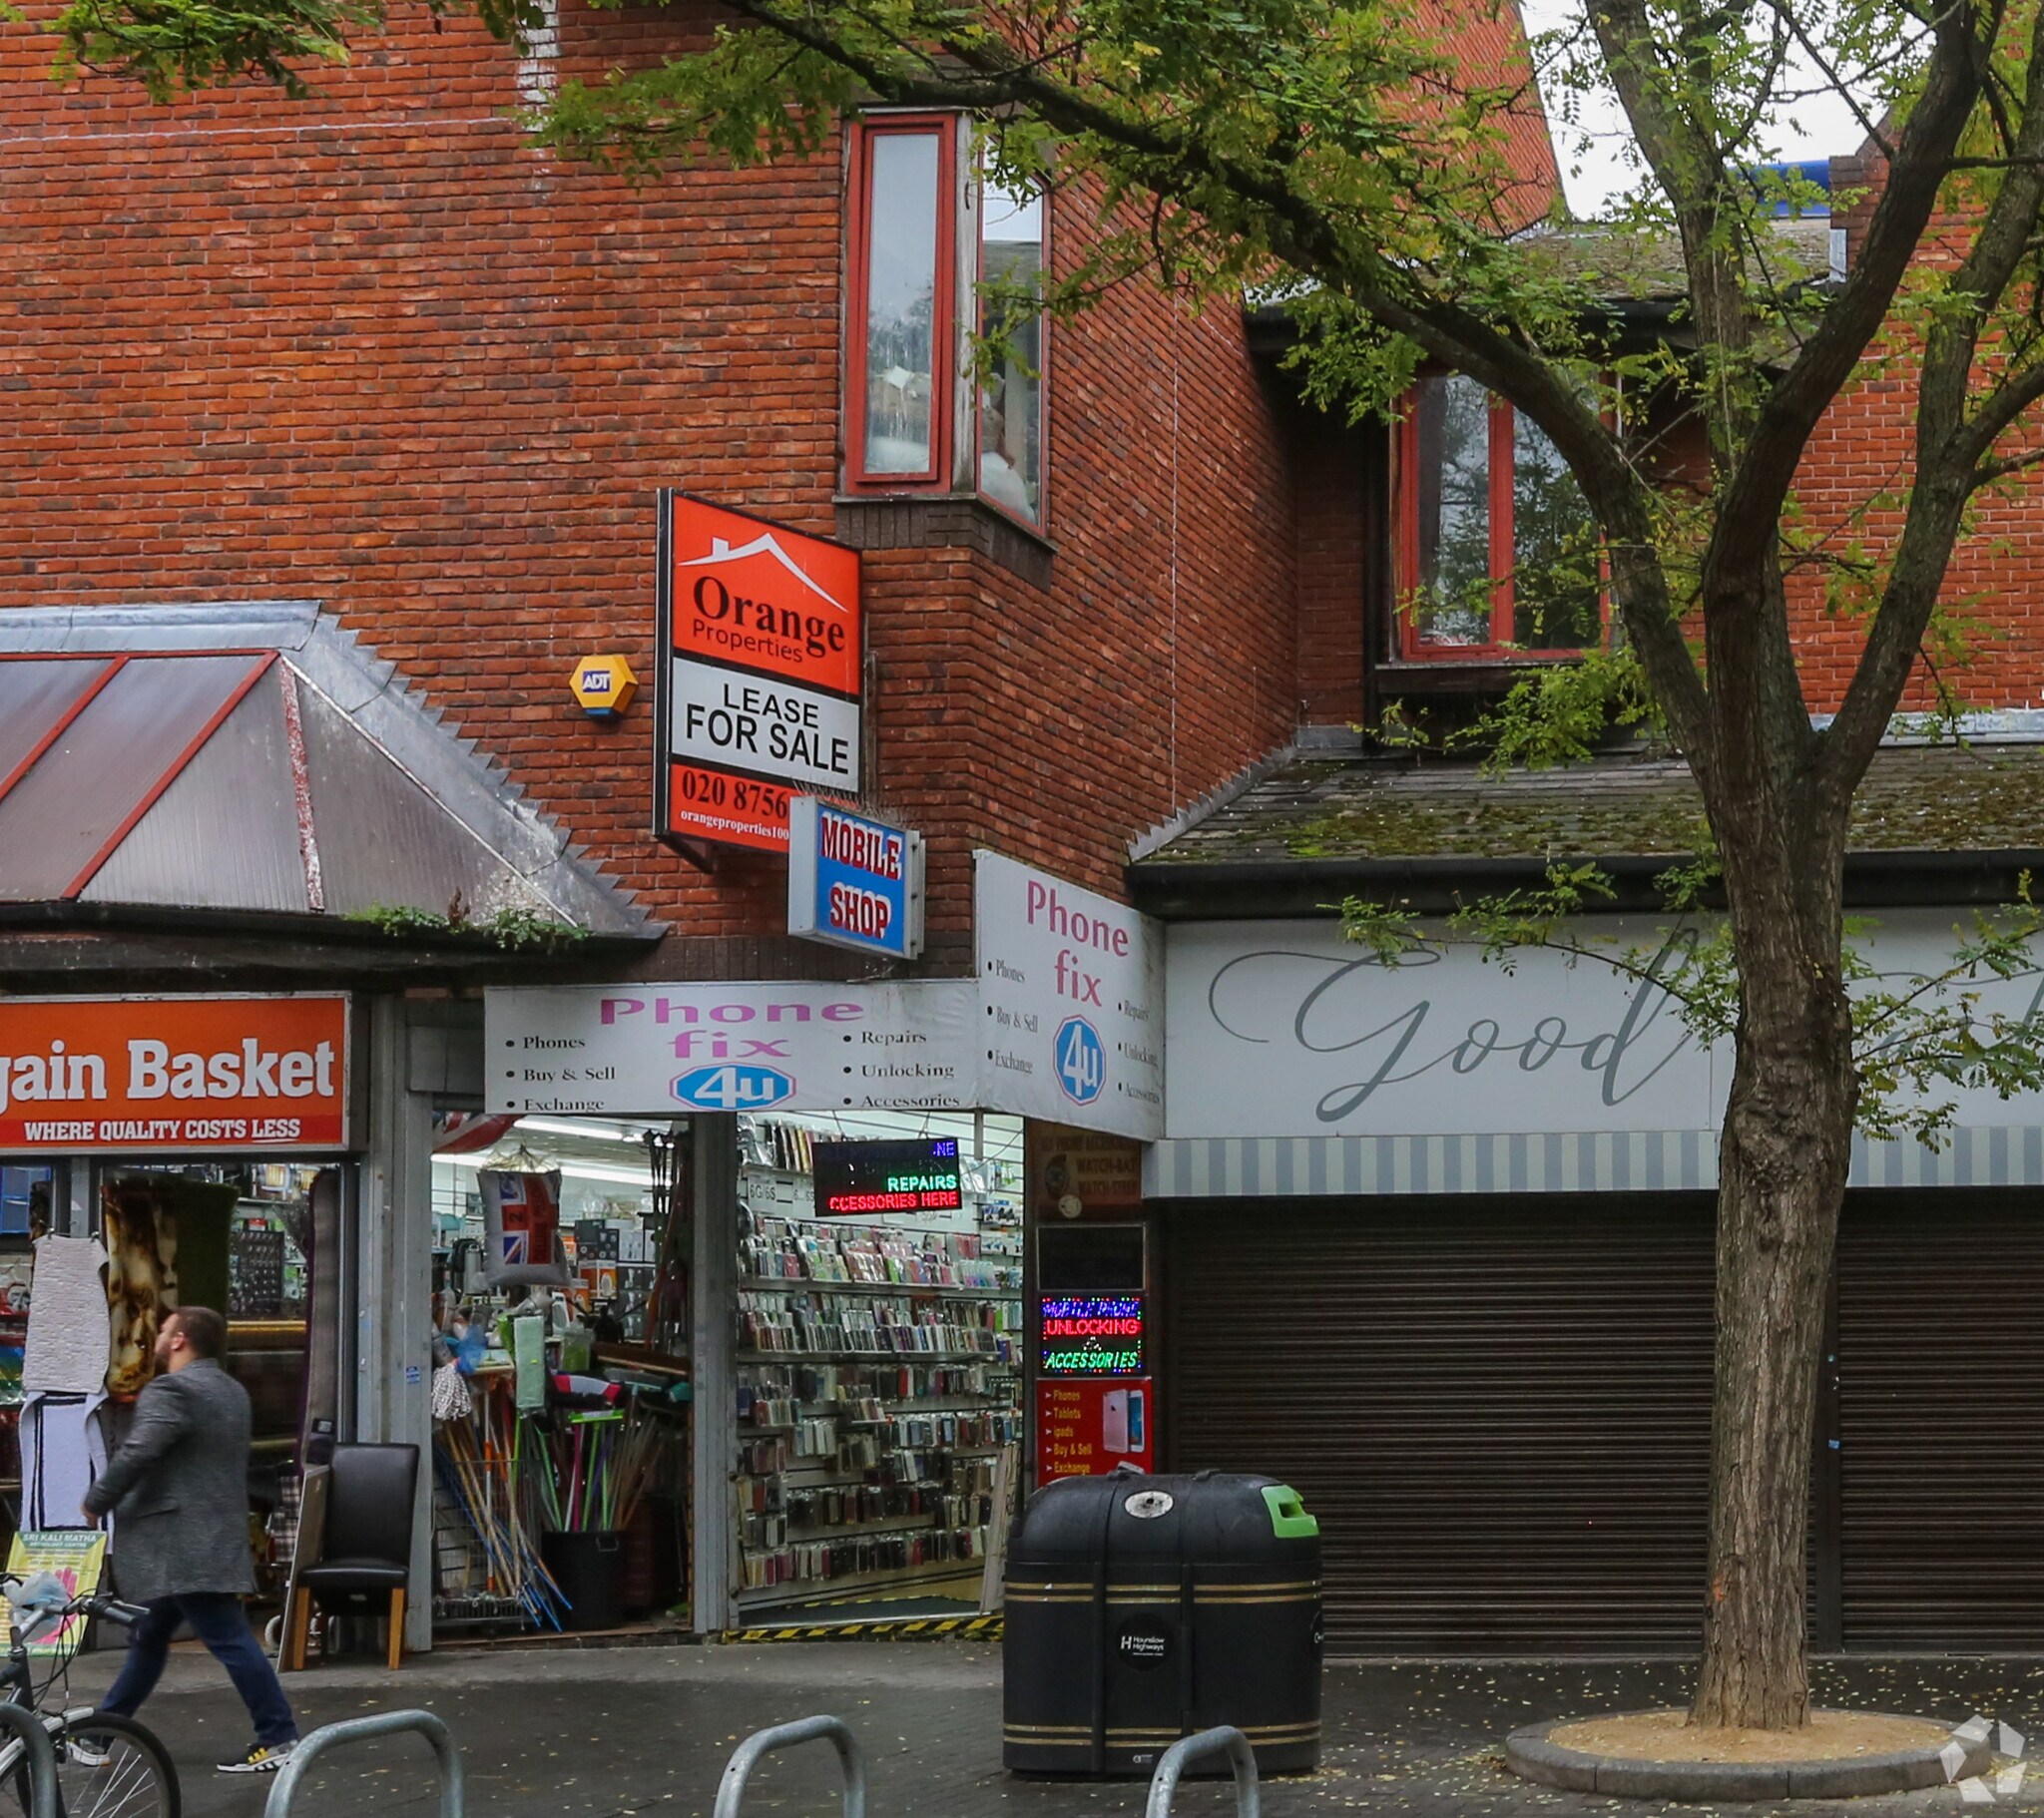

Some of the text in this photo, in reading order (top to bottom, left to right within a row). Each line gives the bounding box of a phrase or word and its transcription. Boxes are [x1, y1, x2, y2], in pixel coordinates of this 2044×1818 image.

[693, 576, 845, 659] Orange
[693, 619, 803, 663] Properties
[582, 673, 611, 689] ADT
[724, 682, 818, 728] LEASE
[686, 702, 848, 774] FOR SALE
[683, 770, 787, 818] 020 8756
[820, 810, 902, 880] MOBILE
[829, 881, 891, 939] SHOP
[1027, 880, 1129, 957] Phone
[996, 958, 1025, 983] Phones
[1054, 949, 1102, 1007] fix
[601, 998, 864, 1025] Phone
[997, 1006, 1010, 1030] Buy
[1024, 1014, 1038, 1033] Sell
[1209, 927, 1694, 1123] Good
[523, 1036, 586, 1050] Phones
[668, 1030, 791, 1059] fix
[861, 1030, 927, 1047] Repairs
[127, 1038, 334, 1100] Basket
[524, 1067, 615, 1084] Buy & Sell
[861, 1064, 955, 1080] Unlocking
[524, 1099, 605, 1114] Exchange
[860, 1095, 961, 1109] Accessories
[24, 1119, 300, 1141] WHERE QUALITY COSTS LESS
[887, 1175, 957, 1191] REPAIRS
[921, 1191, 957, 1206] HERE
[1046, 1319, 1139, 1335] UNLOCKING
[1045, 1351, 1139, 1369] ACCESSORIES
[1053, 1389, 1081, 1401] Phones
[1053, 1407, 1081, 1419] Tablets
[1054, 1443, 1068, 1458] Buy
[1078, 1443, 1092, 1455] Sell
[1054, 1461, 1091, 1476] Exchange
[64, 1534, 97, 1543] MATHA
